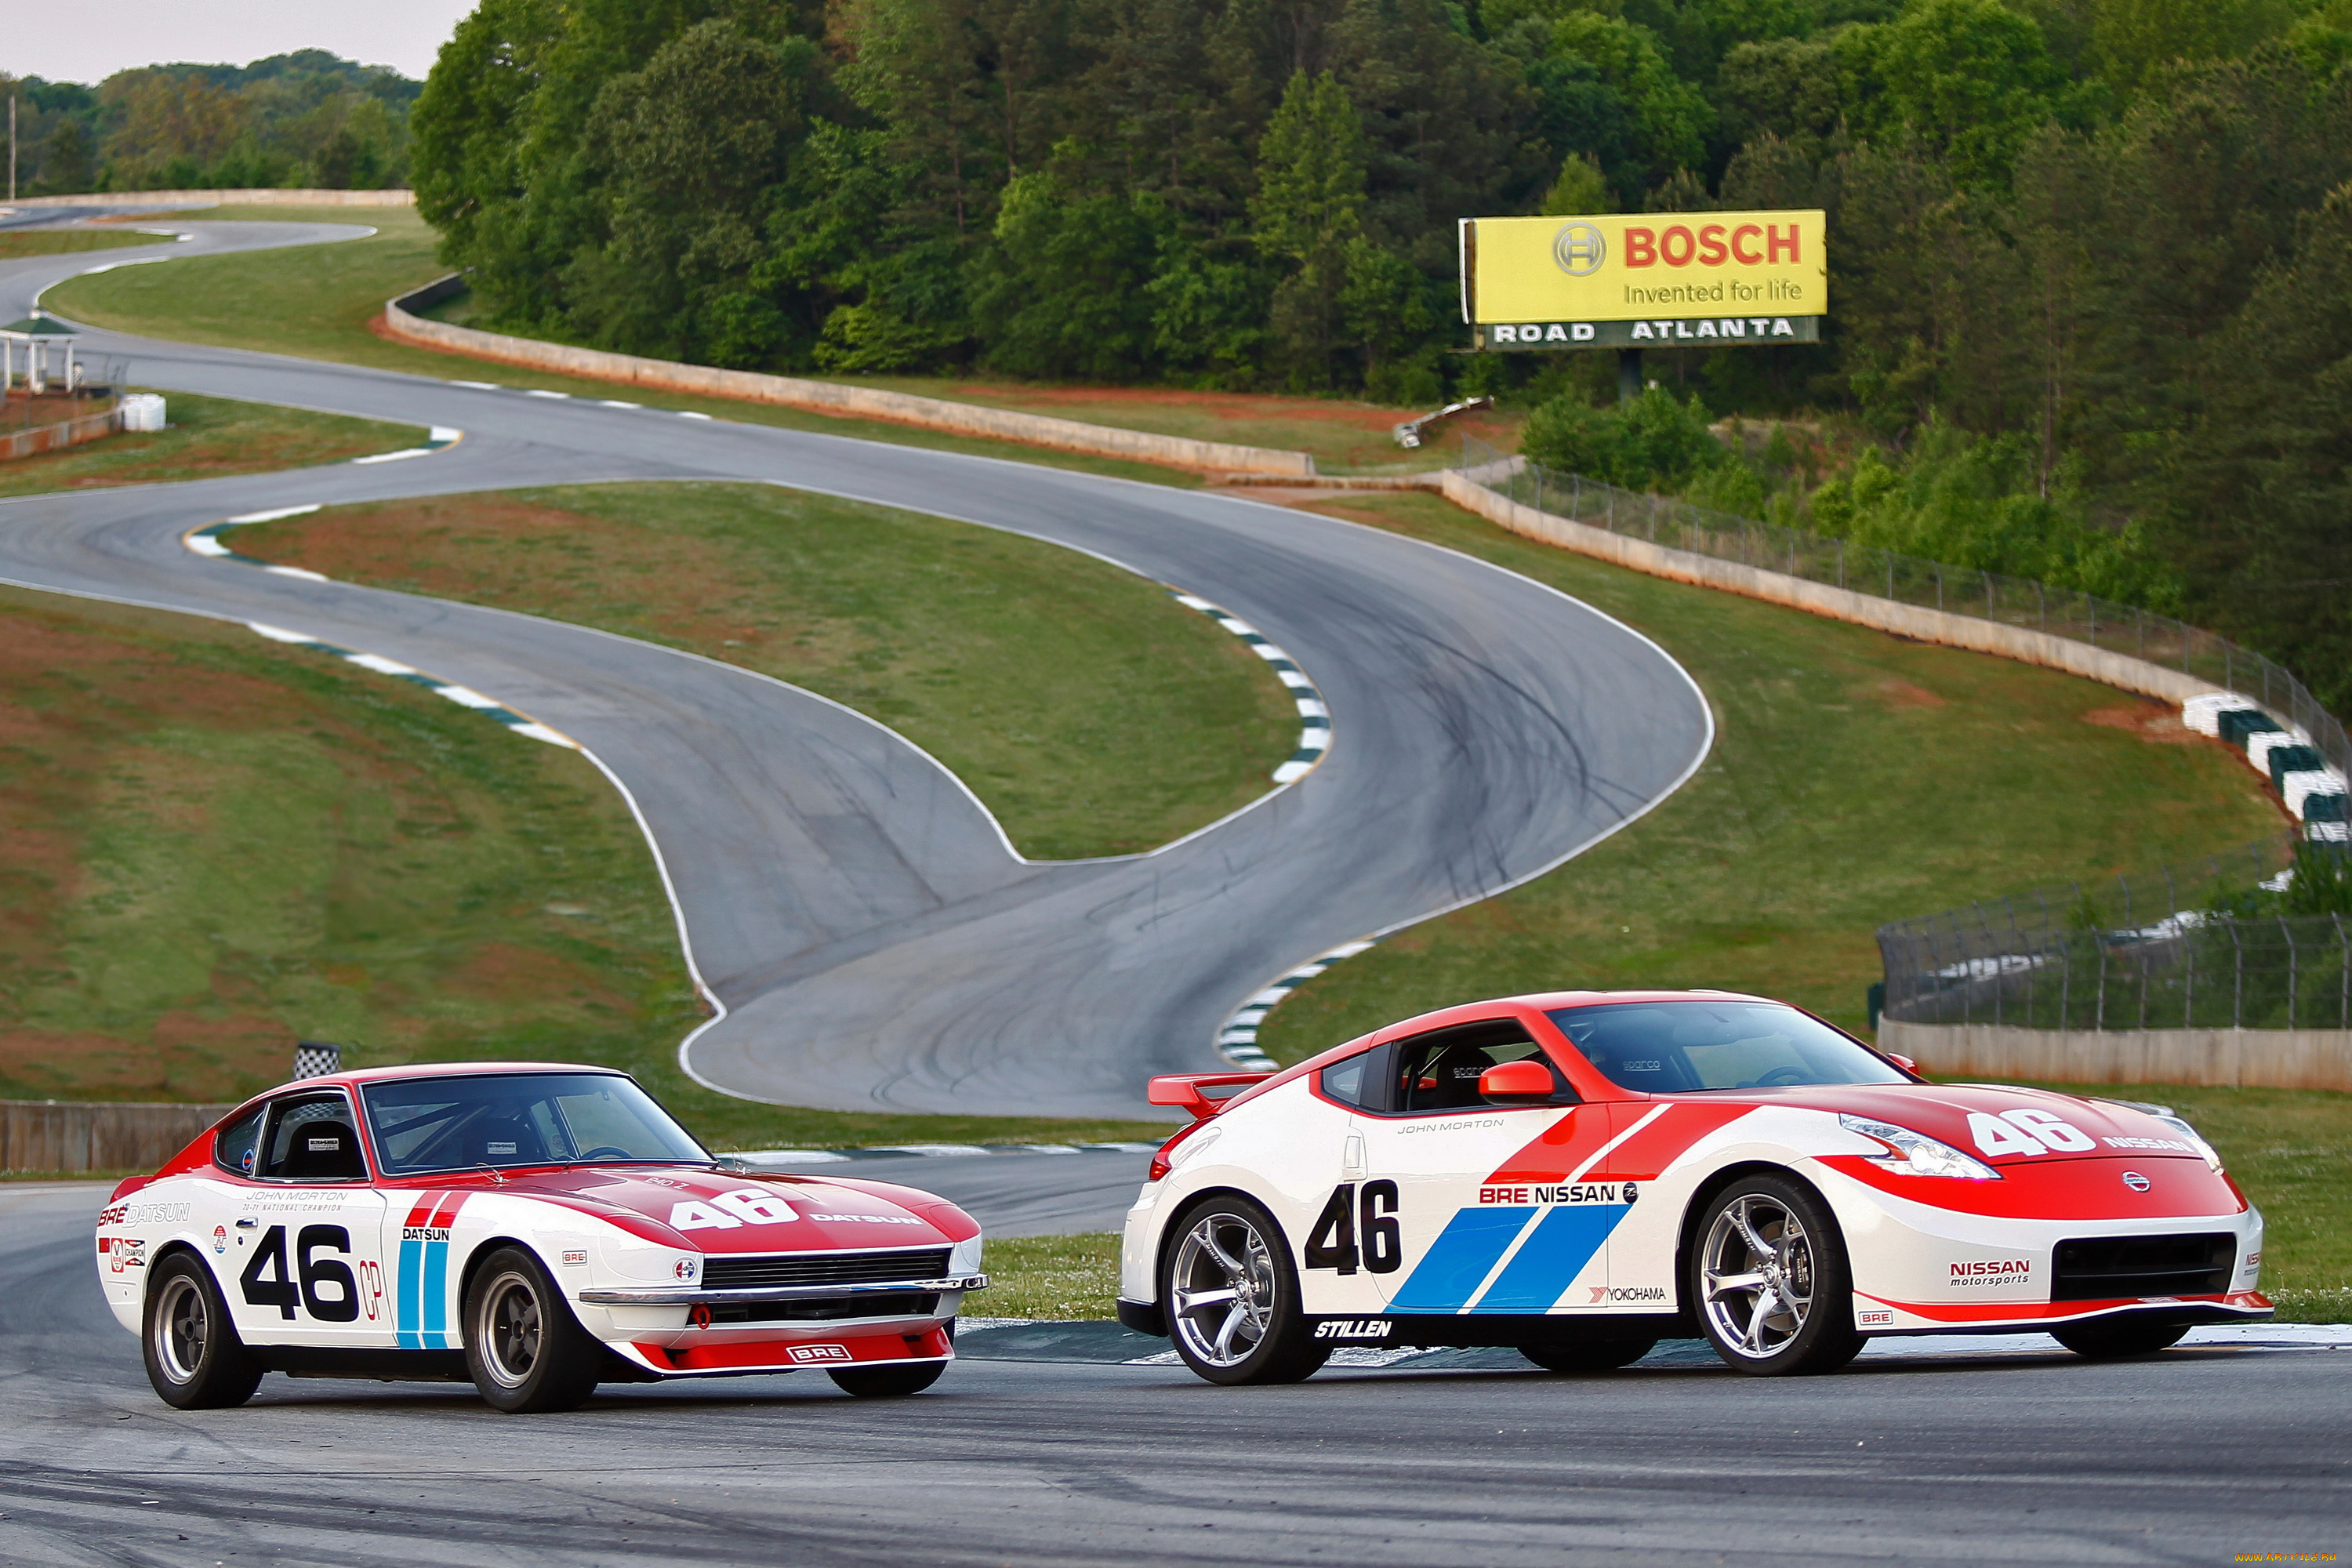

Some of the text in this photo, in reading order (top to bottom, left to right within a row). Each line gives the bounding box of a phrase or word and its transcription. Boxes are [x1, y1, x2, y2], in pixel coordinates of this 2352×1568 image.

[1624, 224, 1800, 268] BOSCH
[1625, 278, 1803, 305] Invented for life
[1494, 317, 1795, 343] ROAD ATLANTA
[1623, 1060, 1661, 1070] sparco
[1397, 1119, 1504, 1134] JOHN MORTON
[1965, 1108, 2097, 1157] 46
[2100, 1136, 2195, 1152] NISSAN
[246, 1192, 348, 1200] JOHN MORTON
[1479, 1188, 1529, 1203] BRE
[1535, 1185, 1615, 1203] NISSAN
[97, 1203, 191, 1227] BRE DATSUN
[668, 1189, 800, 1231] 46
[808, 1213, 924, 1225] DATSUN
[1304, 1178, 1402, 1276] 46
[402, 1228, 450, 1241] DATSUN
[238, 1224, 383, 1323] 46 CP
[1950, 1260, 2031, 1276] NISSAN
[1950, 1274, 2030, 1287] motorsports
[1608, 1287, 1667, 1301] YOKOHAMA
[1862, 1313, 1890, 1323] BRE
[1313, 1320, 1392, 1338] STILLEN
[794, 1348, 845, 1359] BRE
